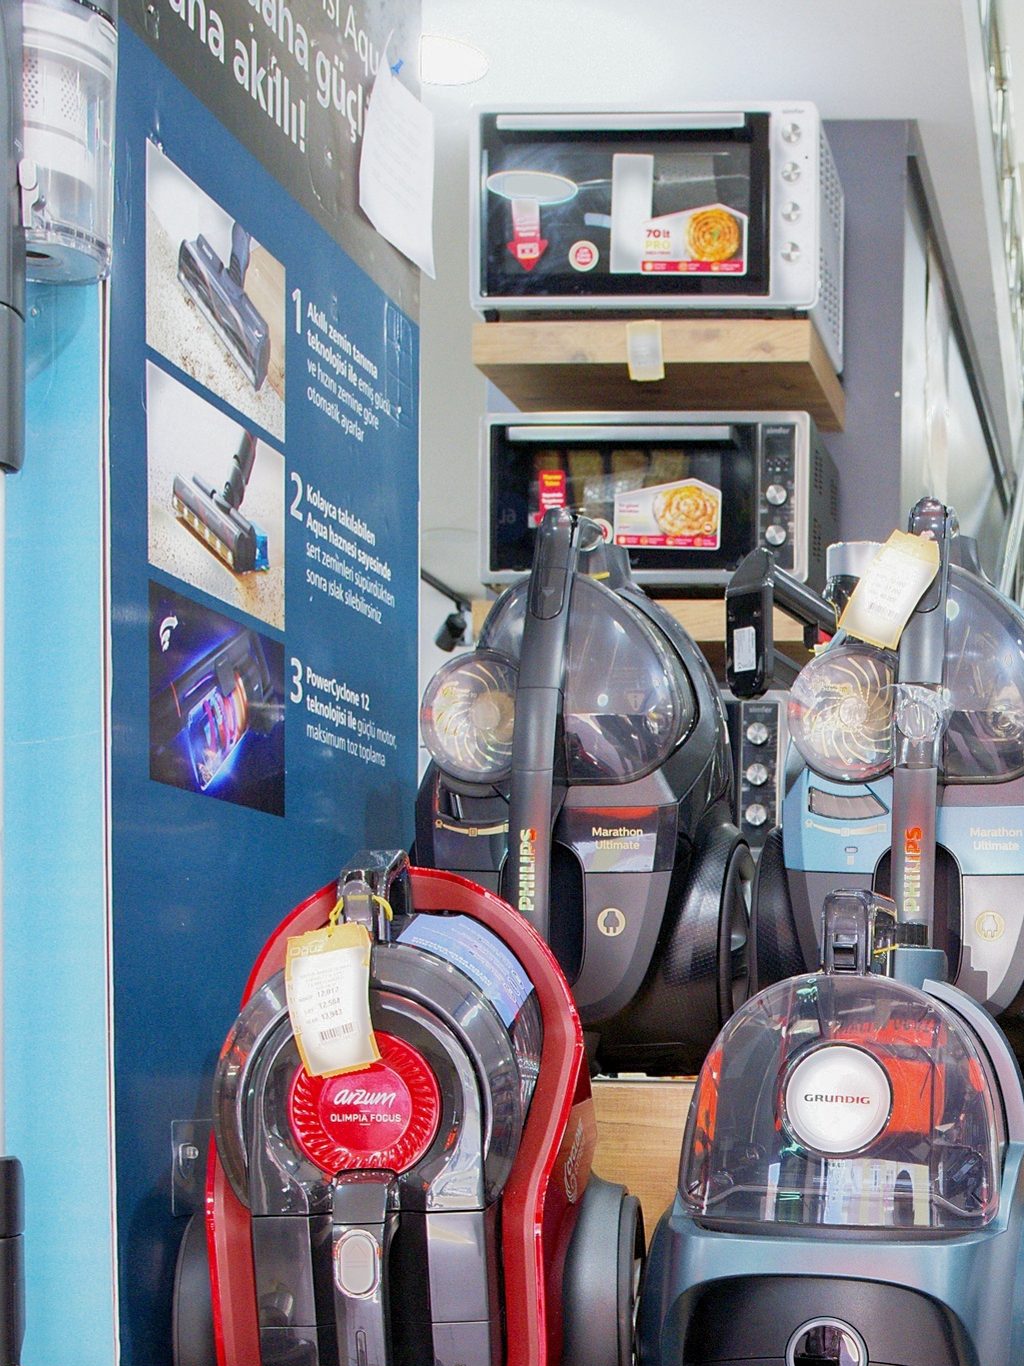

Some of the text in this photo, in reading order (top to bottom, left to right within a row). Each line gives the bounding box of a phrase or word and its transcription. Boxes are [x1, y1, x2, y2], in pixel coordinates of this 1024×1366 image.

[316, 51, 371, 143] güçl
[646, 229, 660, 239] 70
[292, 288, 301, 334] 1
[307, 301, 378, 379] Akıllı zemin tanıma
[307, 329, 347, 377] teknolojisi
[347, 363, 358, 386] ile
[358, 377, 374, 405] emiş
[307, 358, 317, 377] ve
[337, 385, 363, 417] zemine
[363, 407, 379, 431] göre
[307, 386, 365, 443] otomatik ayarlar
[290, 471, 303, 522] 2
[306, 484, 376, 547] Kolayca takılabilen
[306, 512, 392, 581] Aqua haznesi sayesinde
[306, 542, 321, 562] sert
[321, 550, 354, 583] zeminleri
[306, 568, 328, 593] sonra
[344, 587, 383, 625] silebilirsiniz
[290, 657, 303, 704] 3
[306, 665, 370, 712] PowerCyclone 12
[306, 694, 347, 728] teknolojisi
[347, 711, 357, 731] ile
[357, 717, 377, 741] güçlü
[306, 723, 386, 767] maksimum toz toplama
[591, 826, 644, 838] Marathon
[594, 839, 641, 851] Ultimate
[969, 827, 1023, 839] Marathon
[972, 840, 1021, 852] Ultimate
[518, 827, 537, 912] PHILIPS
[903, 826, 923, 913] PHILIPS
[330, 1113, 402, 1123] OLIMPIA FOCUS
[333, 1089, 396, 1108] arzum
[804, 1094, 871, 1105] GRUNDIG
